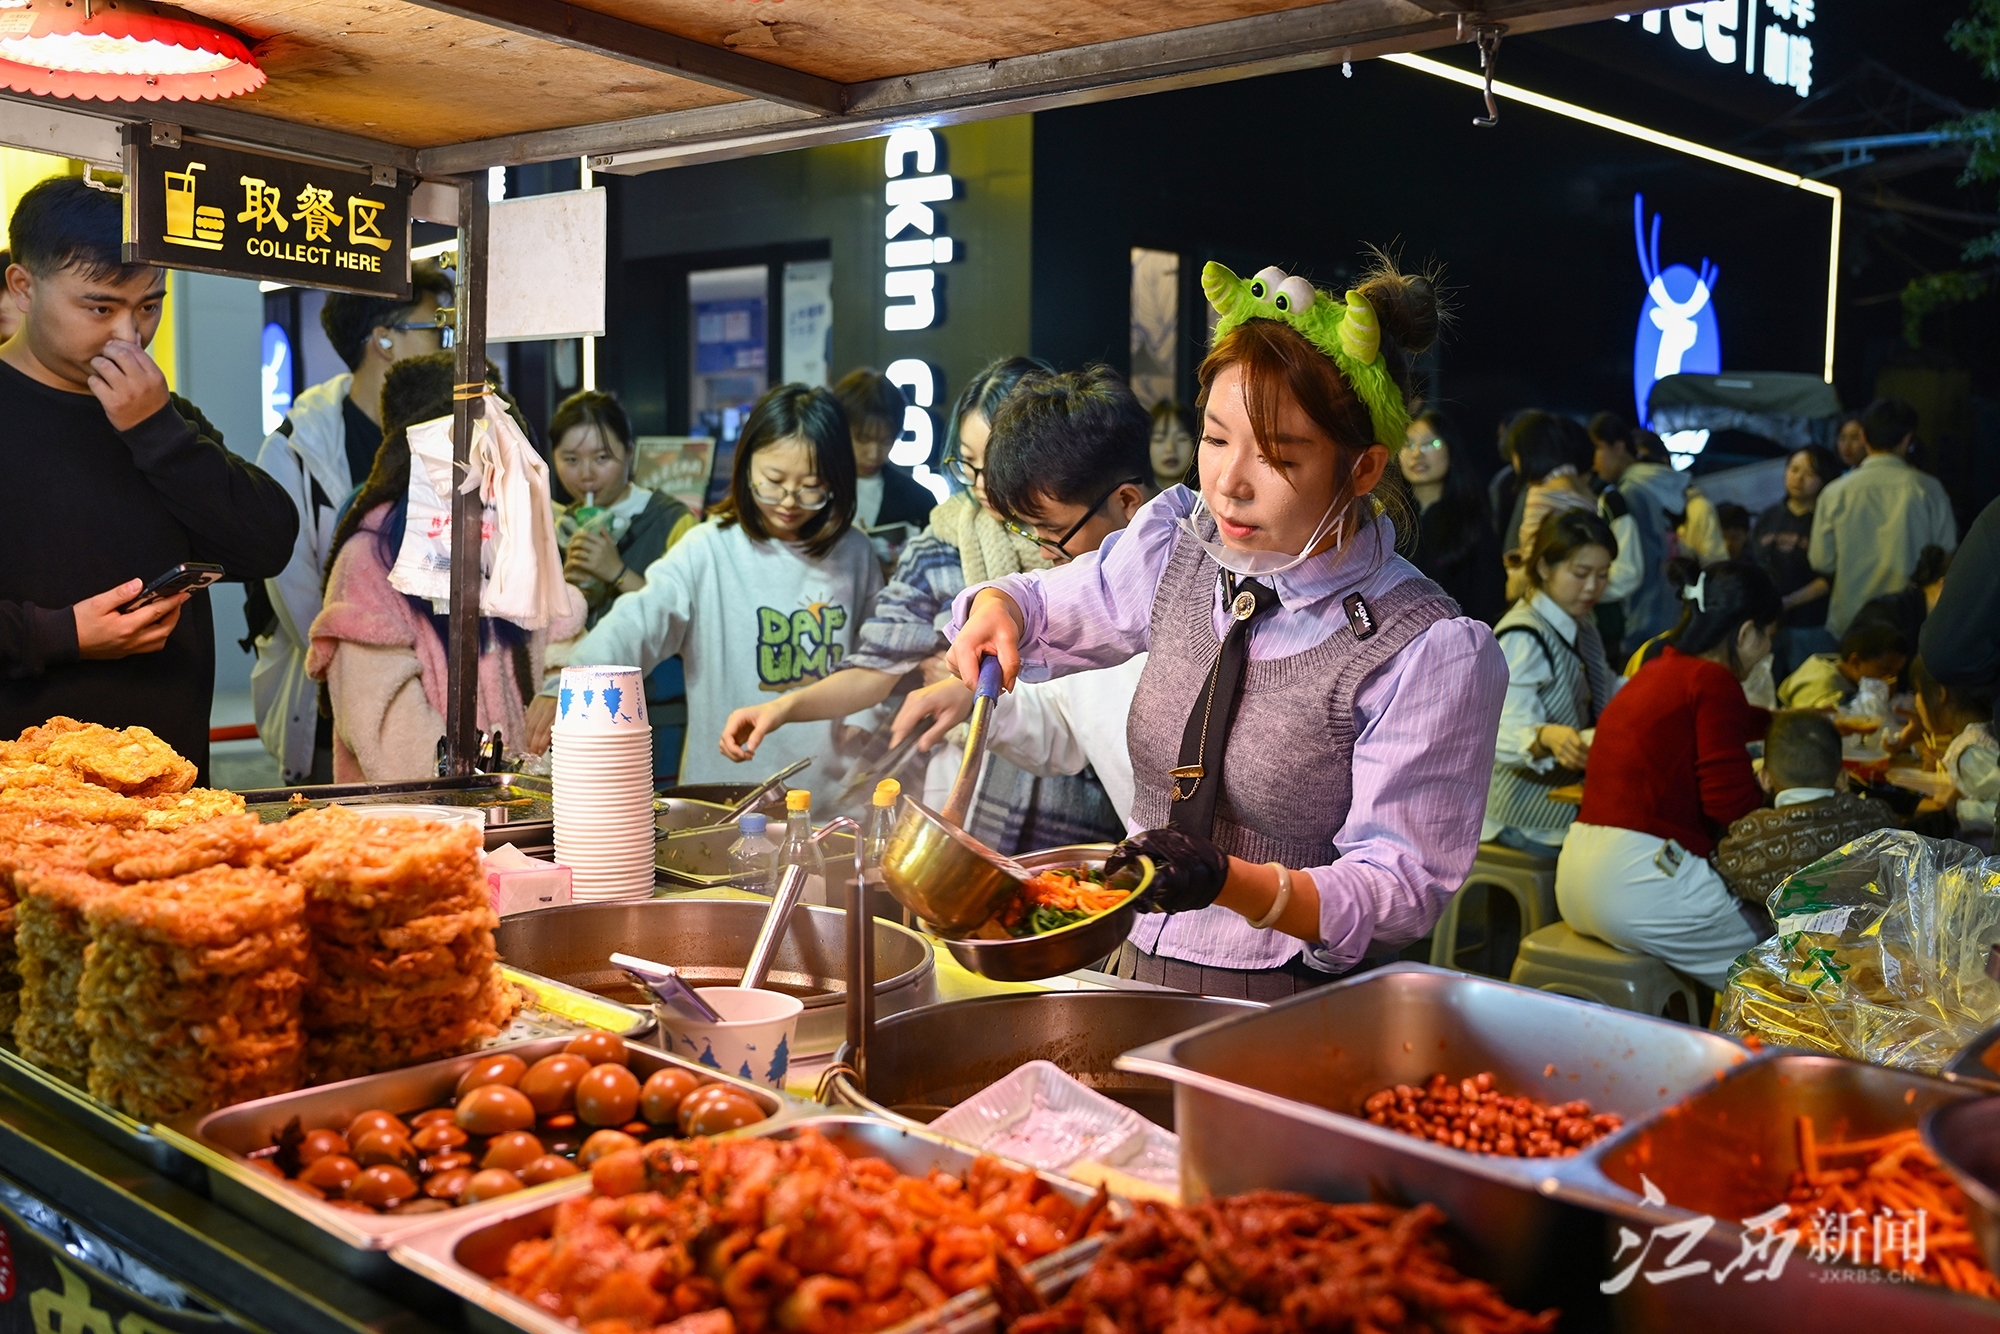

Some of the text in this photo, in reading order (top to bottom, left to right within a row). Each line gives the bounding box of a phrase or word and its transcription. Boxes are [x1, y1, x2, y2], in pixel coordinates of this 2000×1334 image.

[236, 175, 393, 252] 取餐区
[246, 237, 382, 273] COLLECT HERE
